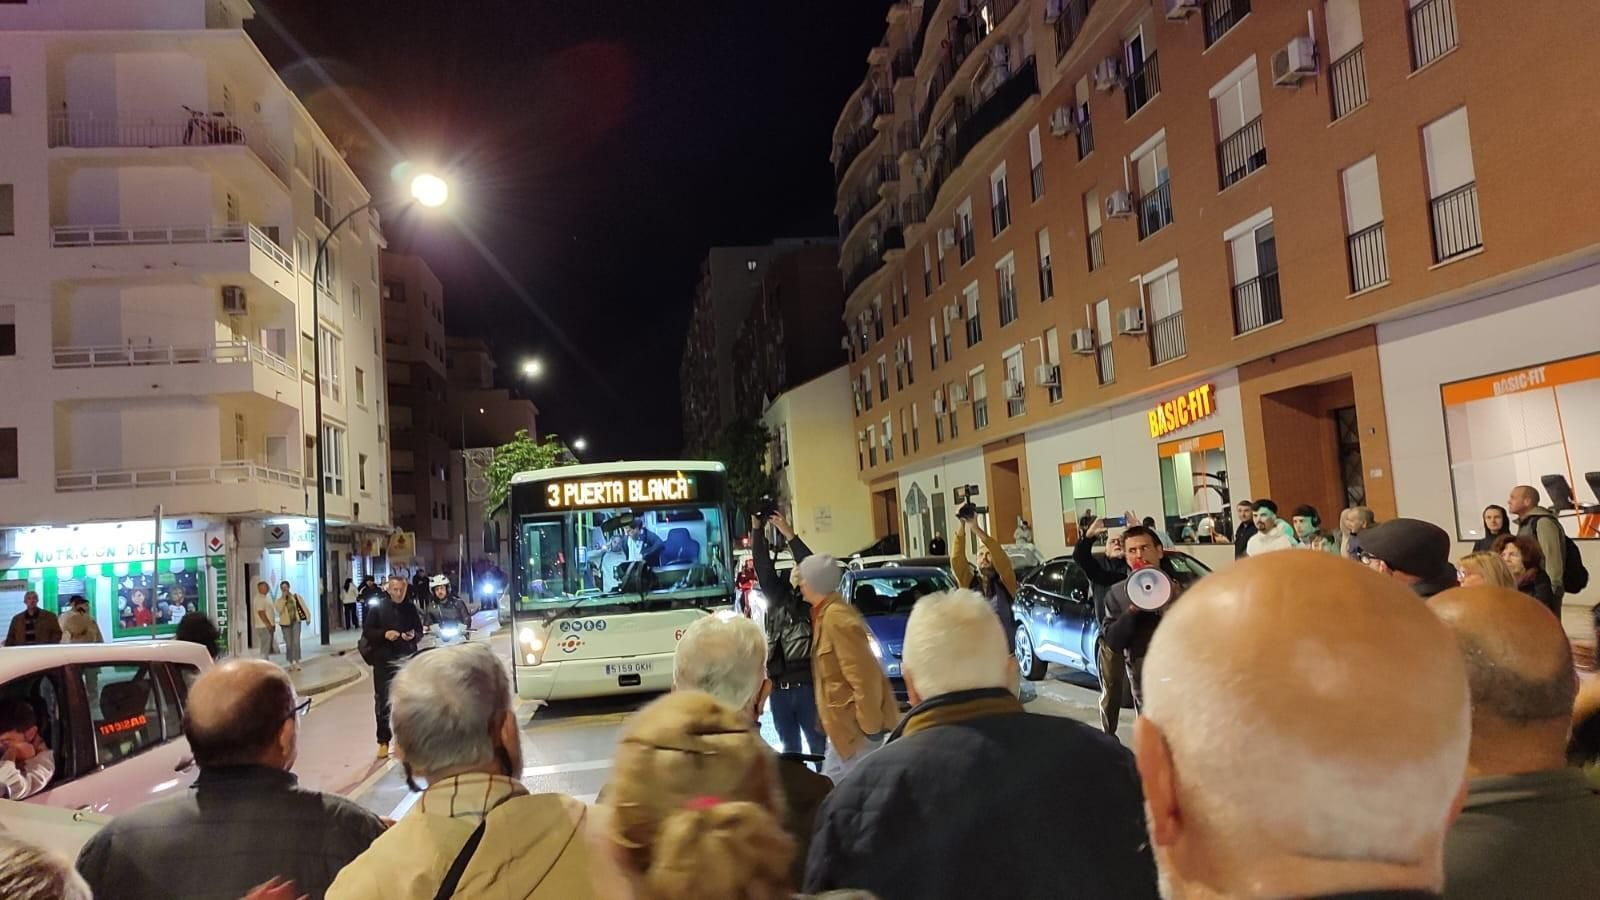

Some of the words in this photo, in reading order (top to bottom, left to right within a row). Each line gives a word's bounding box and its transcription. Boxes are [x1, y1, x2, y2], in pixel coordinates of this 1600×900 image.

[1148, 383, 1211, 438] BASIC-FIT
[547, 484, 560, 507] 3
[563, 480, 624, 506] PUERTA
[627, 477, 688, 502] BLANCA
[34, 546, 115, 564] NUTRCON
[610, 664, 633, 673] 5159
